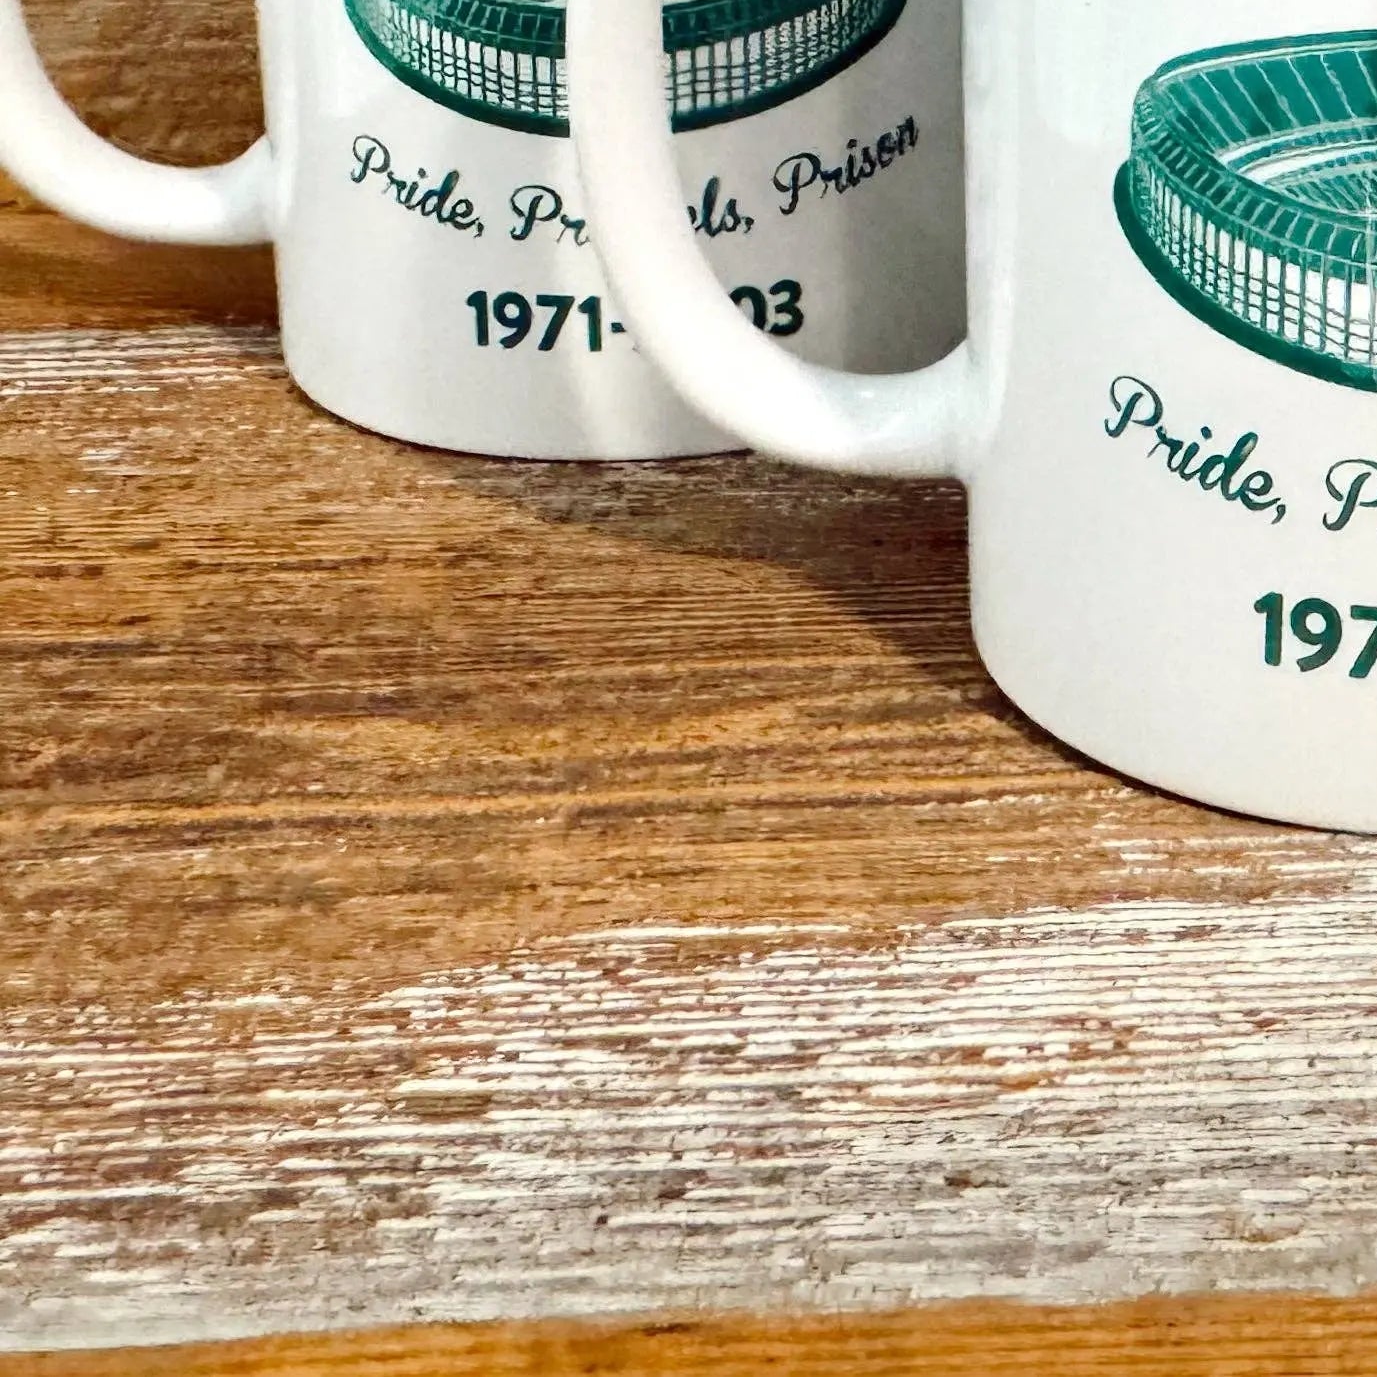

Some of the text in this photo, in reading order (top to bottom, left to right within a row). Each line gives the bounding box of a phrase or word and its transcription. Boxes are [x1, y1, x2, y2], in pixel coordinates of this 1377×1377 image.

[350, 134, 487, 239] Pride,
[772, 114, 919, 217] Prison
[1103, 374, 1287, 525] Pride,
